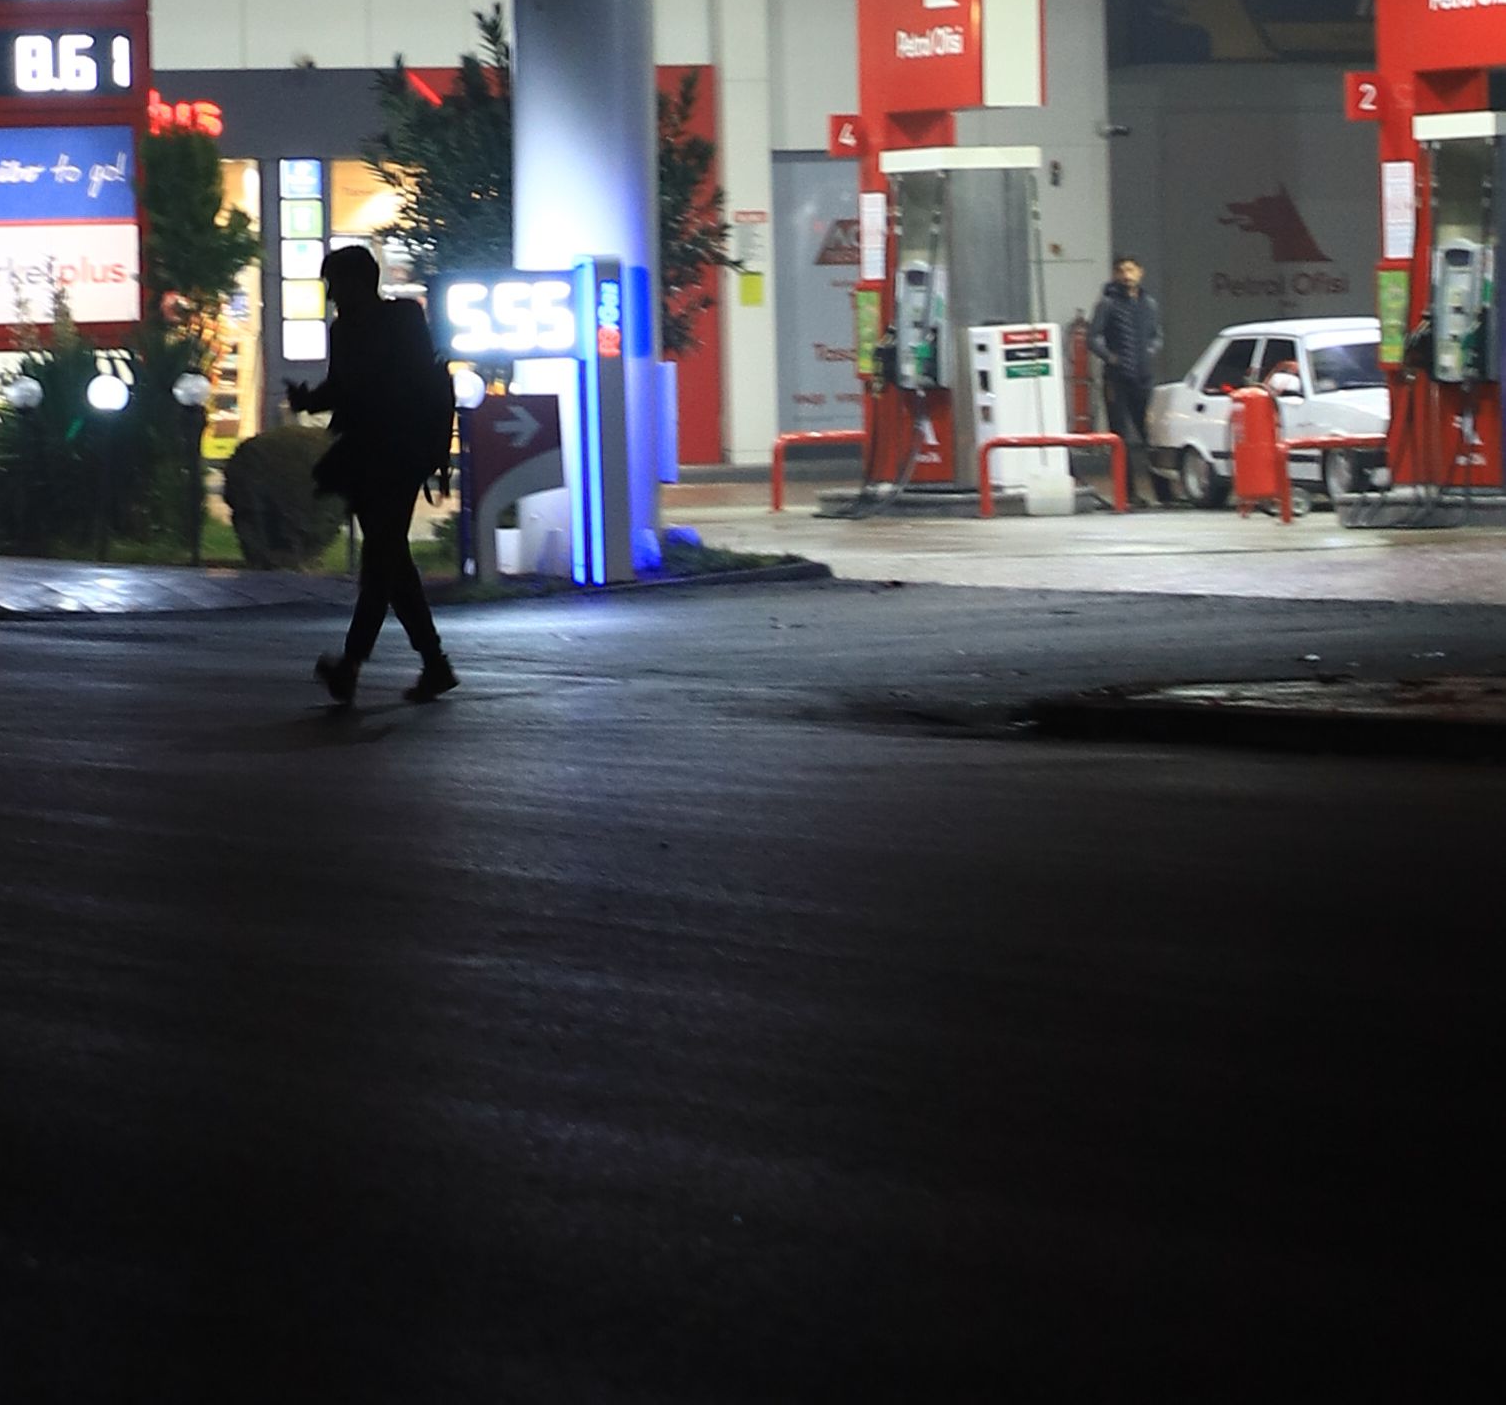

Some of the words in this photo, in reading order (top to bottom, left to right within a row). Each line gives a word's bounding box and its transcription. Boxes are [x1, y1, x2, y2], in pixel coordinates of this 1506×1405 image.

[15, 34, 132, 92] 8.61
[1358, 83, 1377, 110] 2
[837, 123, 855, 146] 4
